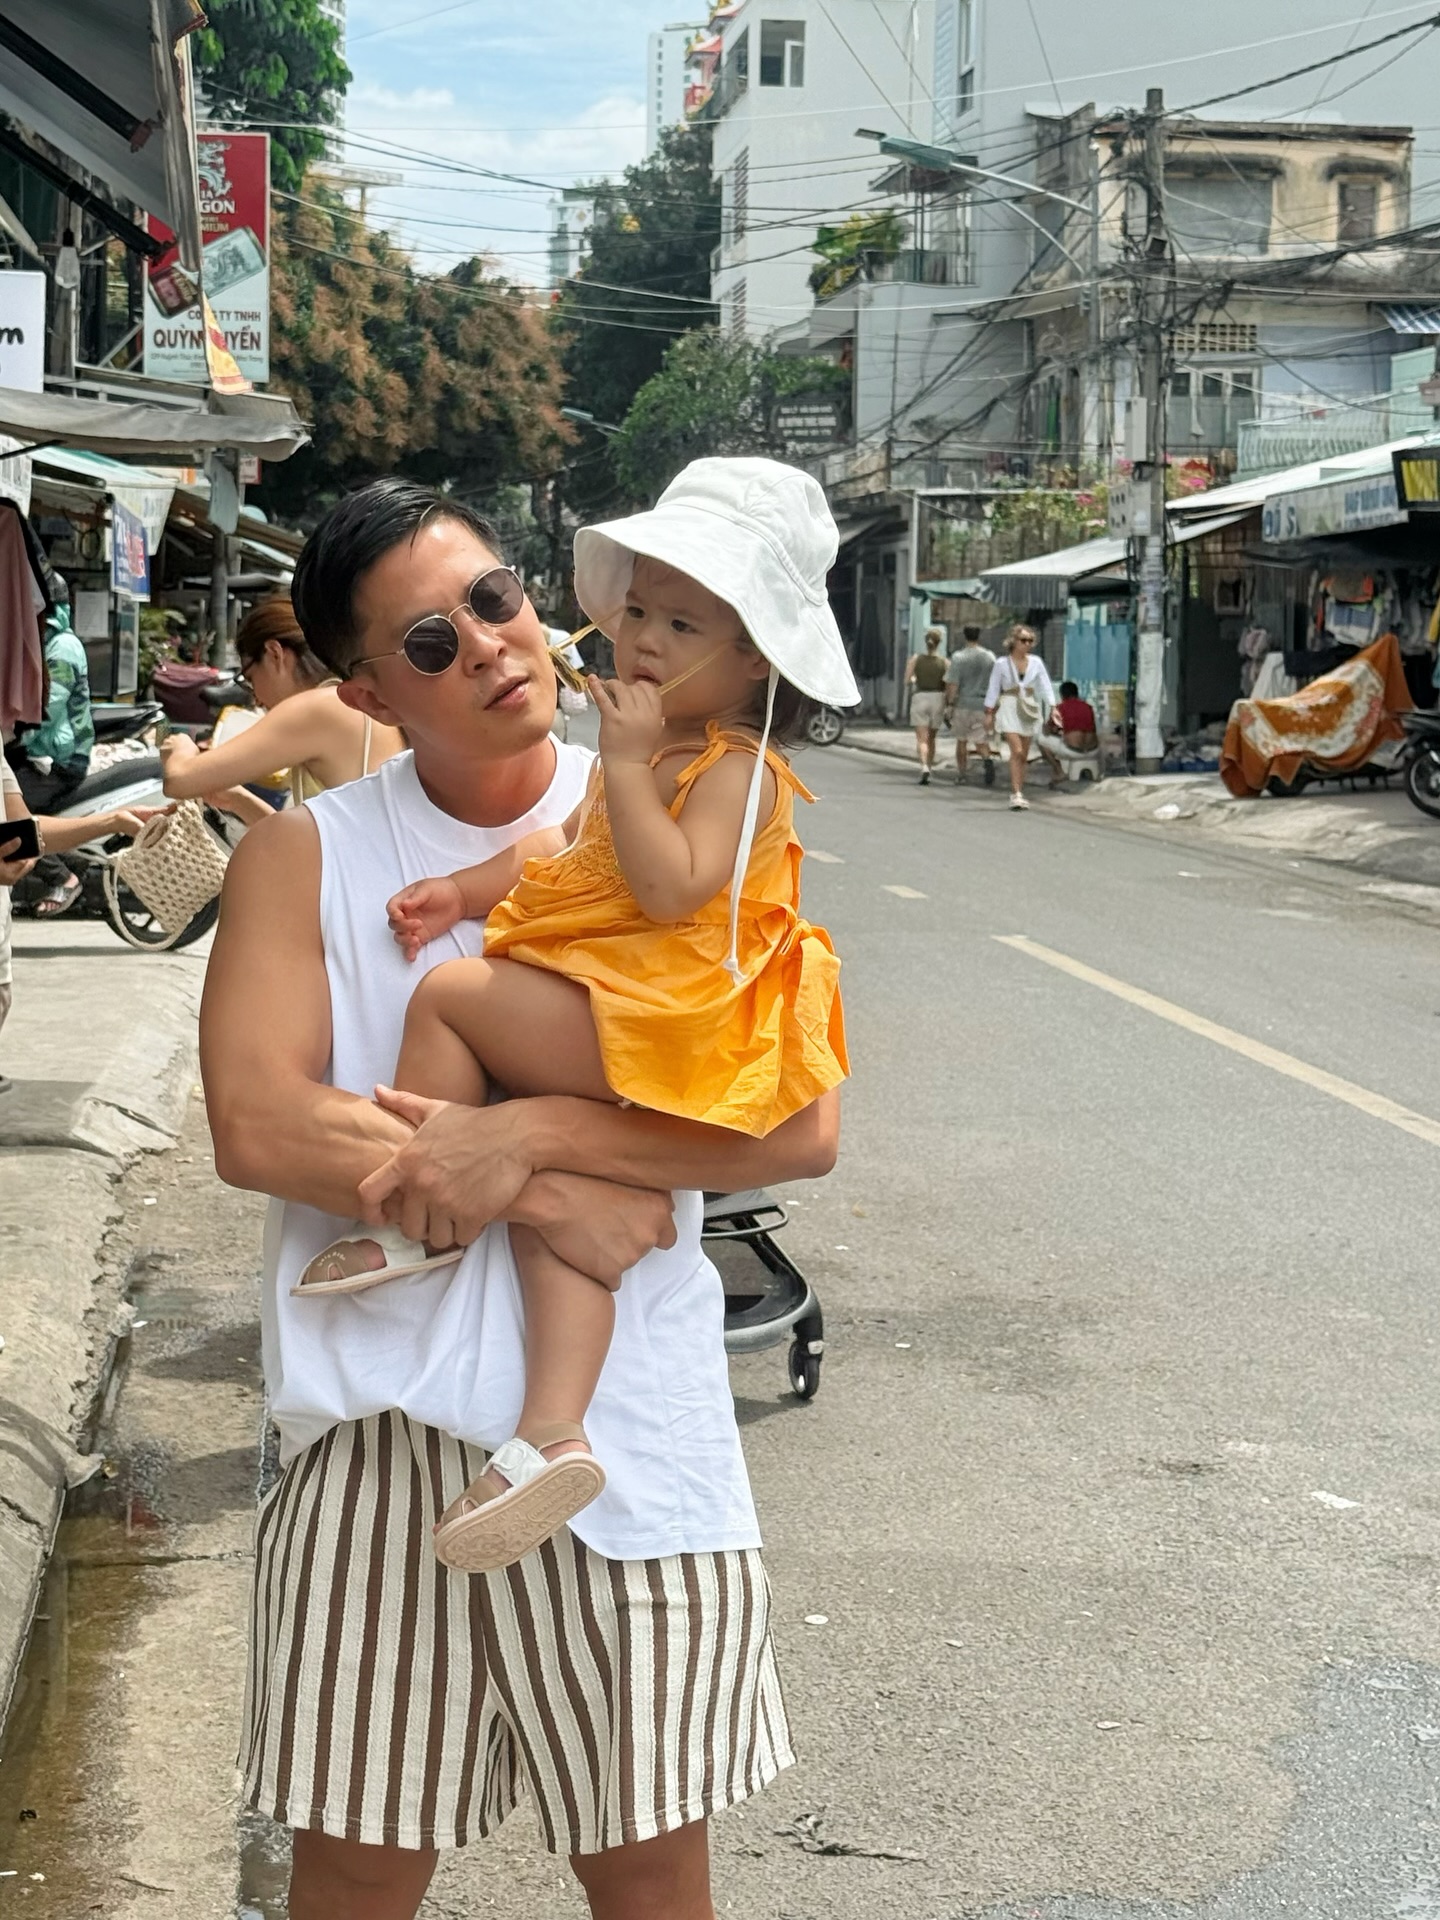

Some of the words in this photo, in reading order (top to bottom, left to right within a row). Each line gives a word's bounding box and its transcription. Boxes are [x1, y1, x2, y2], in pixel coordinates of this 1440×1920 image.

[201, 190, 214, 199] IA
[200, 200, 235, 213] GON
[219, 310, 233, 321] TY
[234, 311, 261, 322] TNHH
